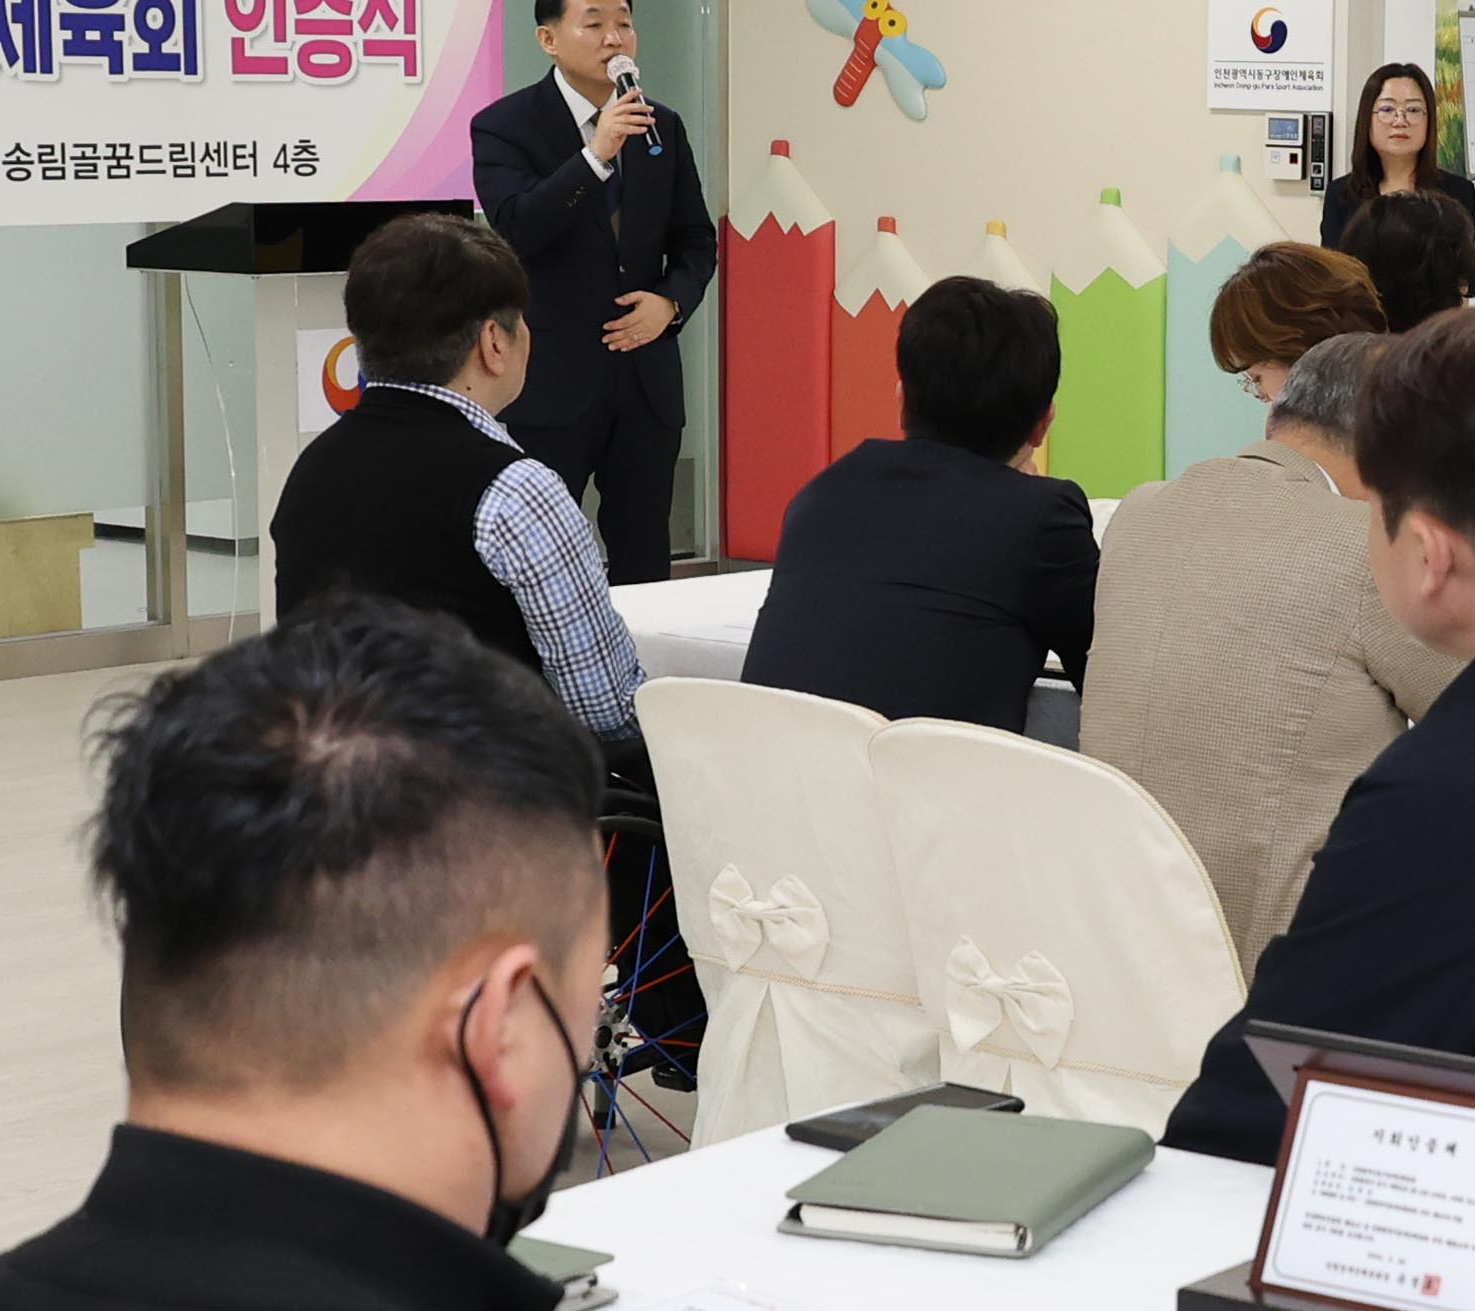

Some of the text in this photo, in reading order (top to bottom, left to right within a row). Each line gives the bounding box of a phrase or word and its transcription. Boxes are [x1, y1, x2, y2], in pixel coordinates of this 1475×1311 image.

[1213, 67, 1325, 82] 인천광역시동구장애인체육회
[0, 140, 259, 182] 송림골꿈드림센터
[272, 138, 321, 177] 4층
